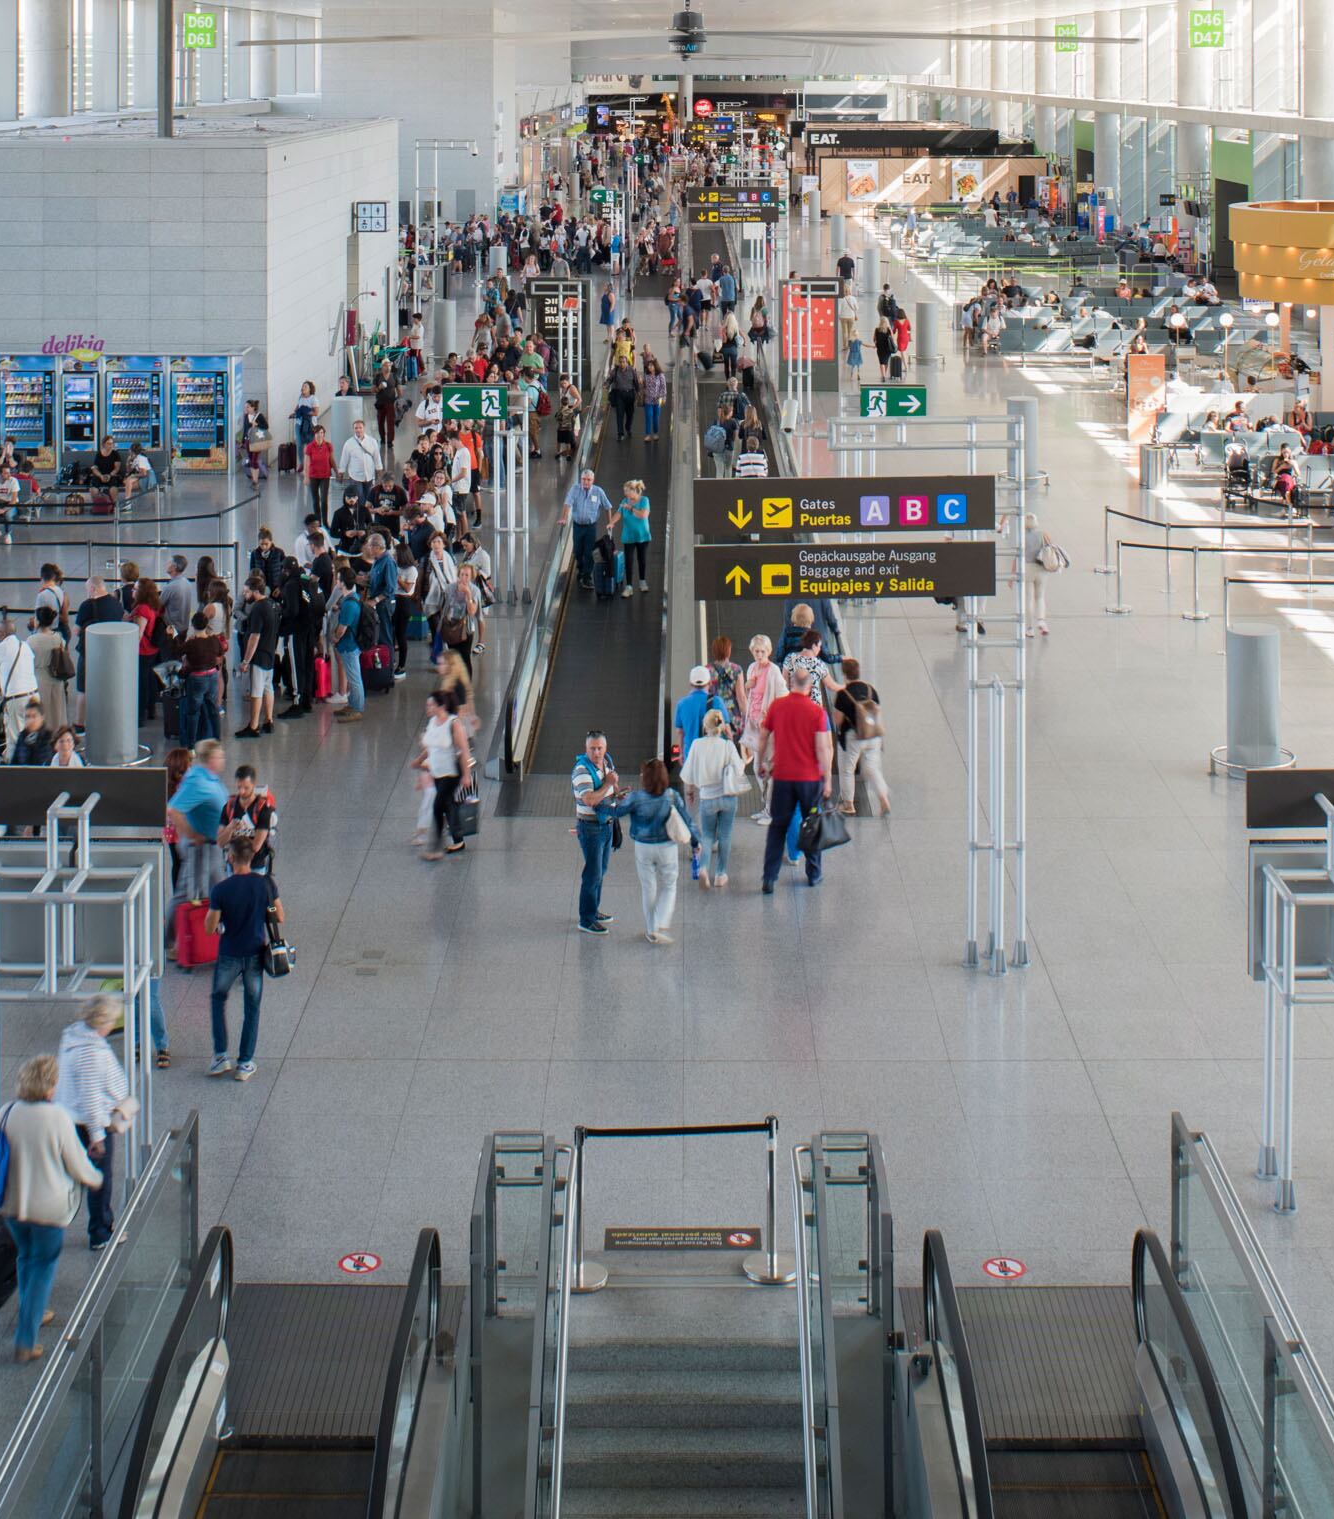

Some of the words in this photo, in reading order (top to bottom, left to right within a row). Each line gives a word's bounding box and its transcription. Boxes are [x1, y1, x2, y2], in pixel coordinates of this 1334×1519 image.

[189, 16, 213, 28] D60
[1194, 14, 1221, 26] D46
[188, 33, 211, 45] D61
[1194, 32, 1221, 44] D47
[810, 133, 840, 144] EAT.
[903, 173, 932, 184] EAT.
[751, 193, 758, 201] B
[42, 334, 105, 354] delikia
[800, 499, 836, 510] Gates
[867, 500, 883, 521] A
[906, 500, 922, 521] B
[944, 499, 960, 521] C
[800, 513, 851, 526] Puertas
[799, 550, 885, 564] Gepäckausgabe
[889, 550, 936, 564] Ausgang
[799, 565, 850, 578] Baggage
[854, 564, 874, 575] and
[879, 564, 899, 575] exit
[800, 579, 871, 595] Equipajes
[875, 581, 884, 595] y
[889, 578, 934, 592] Salida
